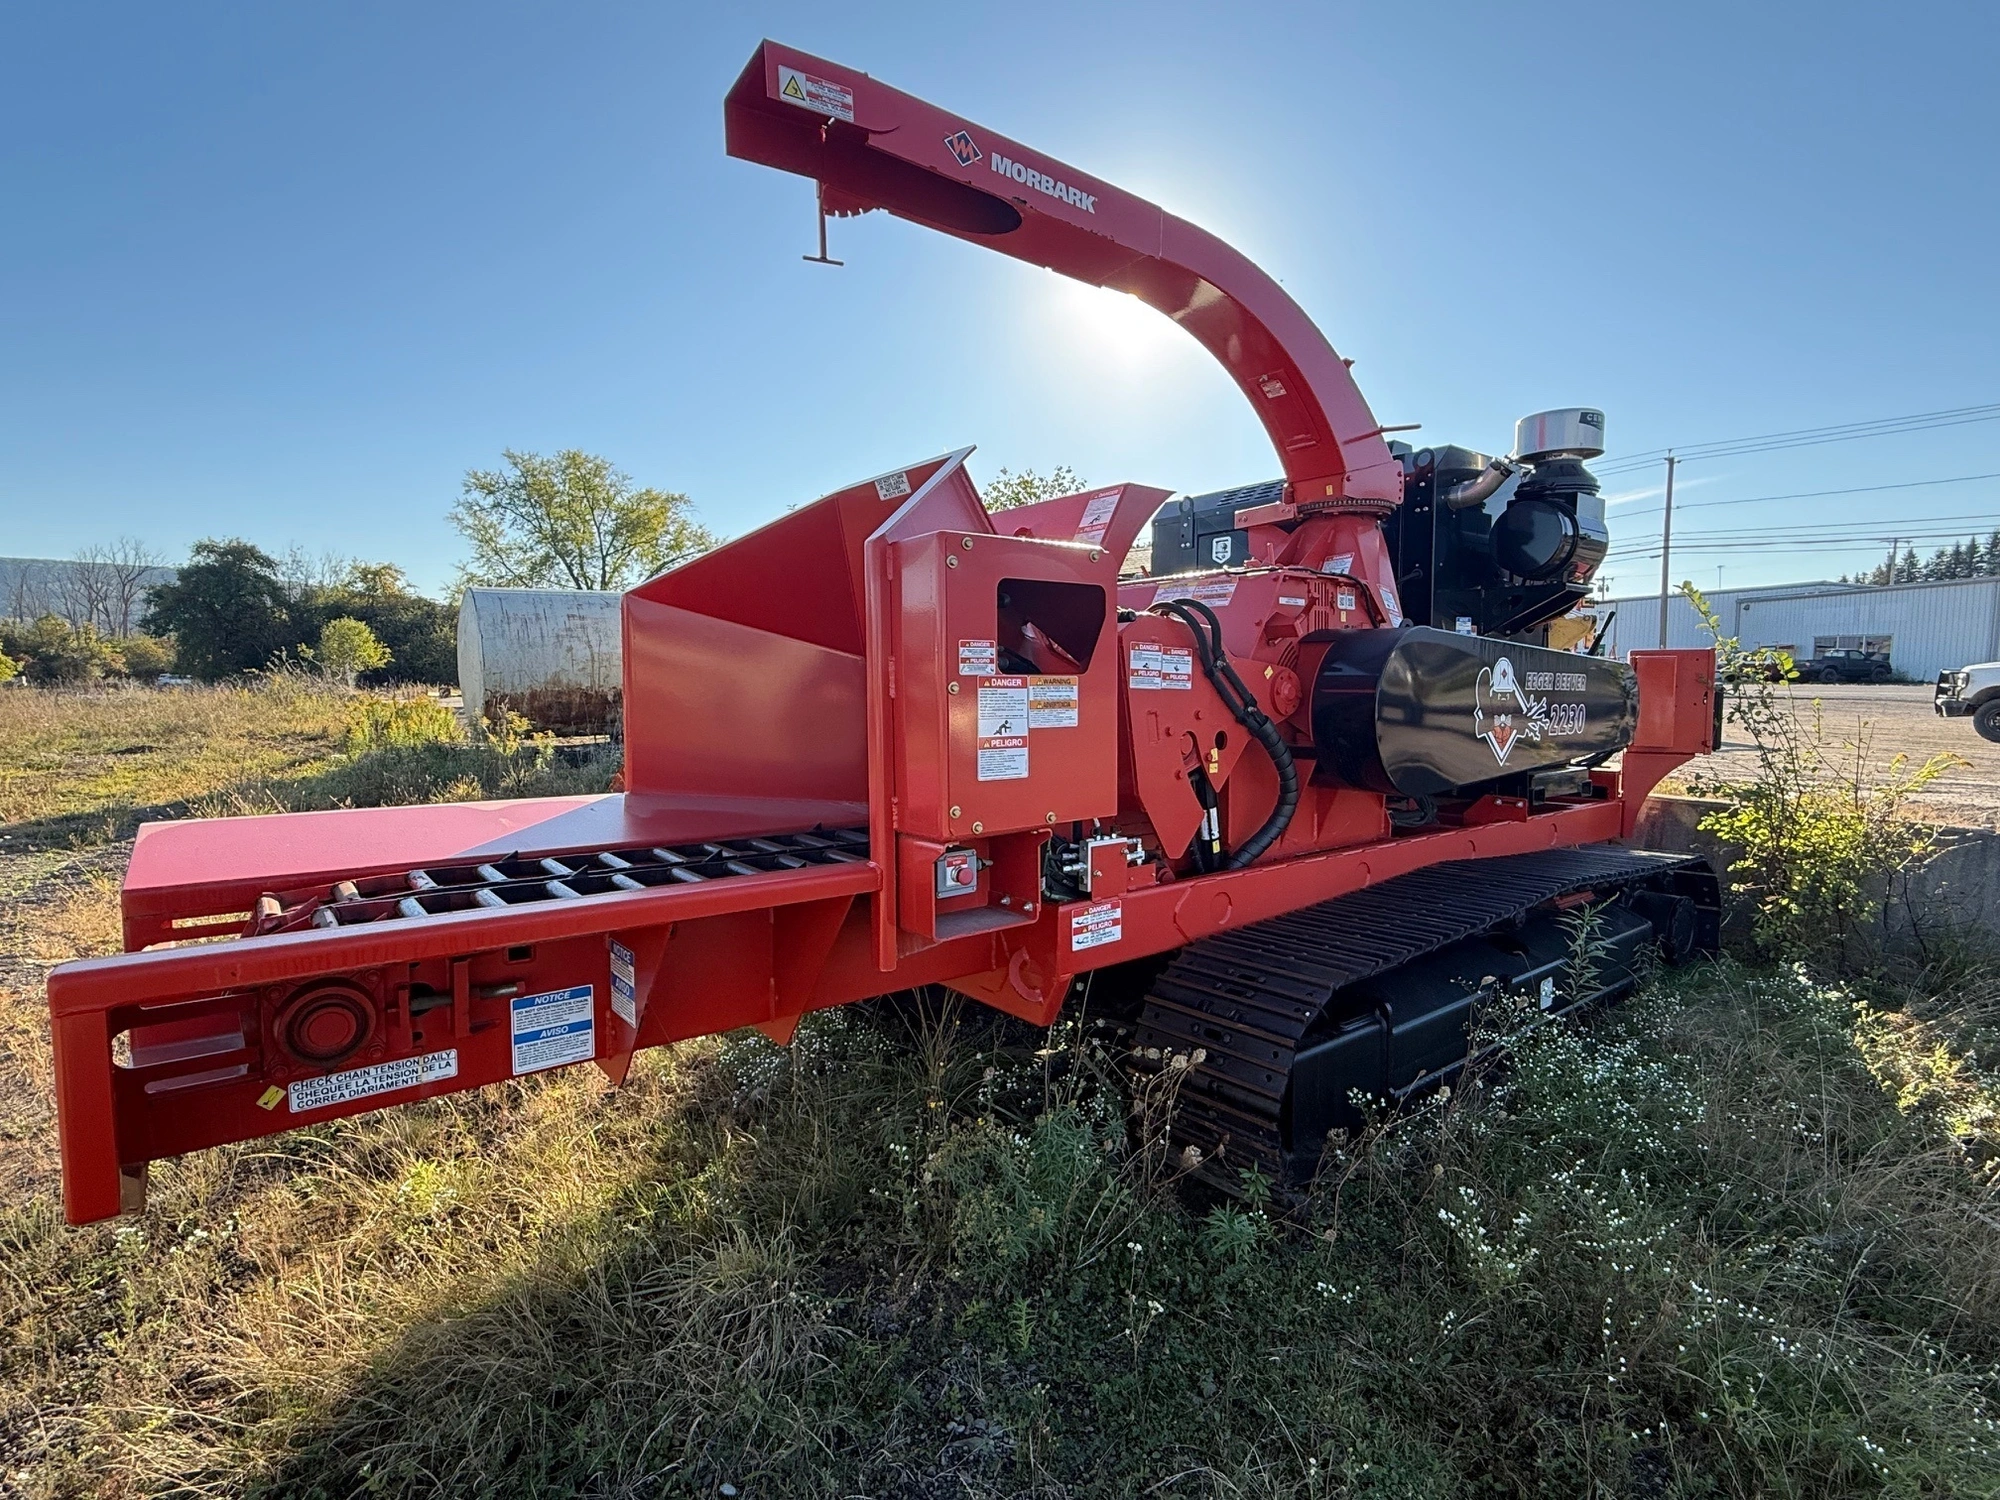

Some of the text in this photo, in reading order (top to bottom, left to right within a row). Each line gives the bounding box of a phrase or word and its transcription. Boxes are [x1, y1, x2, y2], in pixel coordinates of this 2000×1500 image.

[991, 152, 1095, 214] MORBARK
[1525, 672, 1586, 691] EEGER BEEVER
[1549, 704, 1586, 736] 2230
[991, 739, 1023, 747] PELIGRO
[1089, 904, 1112, 914] DANGER
[1088, 920, 1112, 931] PELIGRO
[613, 942, 631, 963] NOTICE
[534, 991, 571, 1005] NOTICE
[540, 1026, 569, 1038] AVISO
[292, 1051, 452, 1092] CHECK CHAIN TENSION DAILY
[296, 1060, 452, 1100] CHEQUEE LA TENSION DE LA
[297, 1075, 421, 1109] CORREA DIARIAMENTE
